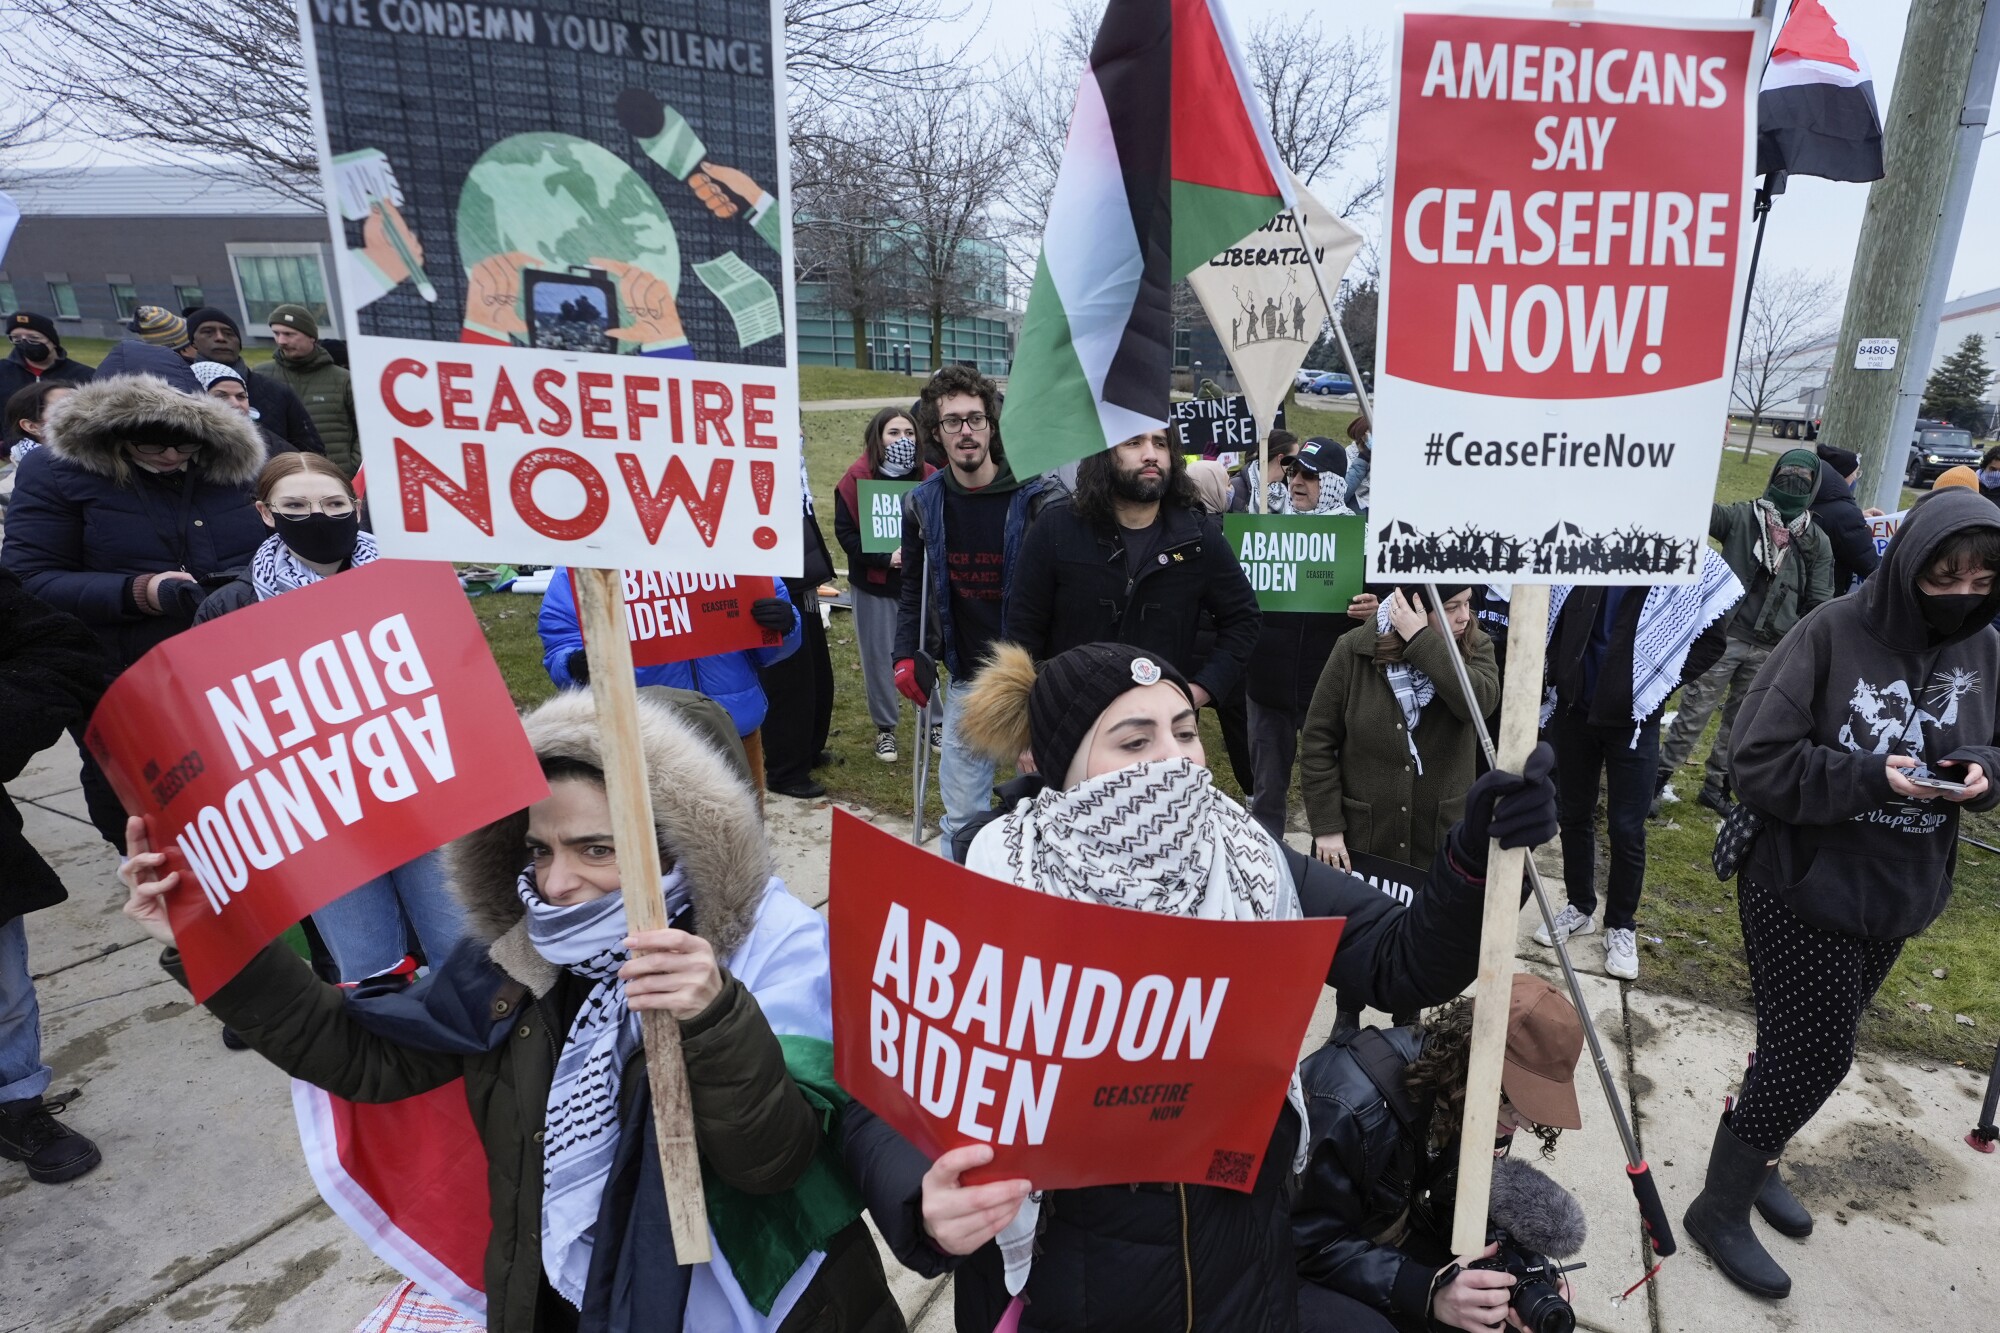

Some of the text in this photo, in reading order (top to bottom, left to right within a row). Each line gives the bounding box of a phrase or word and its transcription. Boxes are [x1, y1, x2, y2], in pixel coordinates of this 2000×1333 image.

[313, 0, 371, 28] WE
[378, 0, 535, 44] CONDEMN
[542, 11, 635, 57] YOUR
[640, 27, 764, 76] SILENCE
[1421, 40, 1727, 109] AMERICANS
[1531, 115, 1617, 171] SAY
[1403, 187, 1730, 267] CEASEFIRE
[1452, 283, 1669, 375] NOW!
[1859, 345, 1896, 355] 8480-S
[379, 357, 778, 450] CEASEFIRE
[1170, 396, 1237, 420] LESTINE
[1424, 431, 1676, 468] #CeaseFireNow
[393, 437, 779, 550] NOW!
[1240, 531, 1336, 562] ABANDON
[620, 569, 736, 602] BANDON
[1306, 570, 1334, 579] CEASEFIRE
[624, 597, 692, 642] IDEN
[702, 599, 739, 614] CEASEFIRE
[205, 613, 434, 771] BIDEN
[176, 694, 456, 915] ABANDON
[1868, 809, 1915, 828] Vape
[1920, 812, 1947, 827] Shop
[872, 901, 1230, 1062] ABANDON
[870, 988, 1062, 1146] BIDEN
[1093, 1082, 1194, 1108] CEASEFIRE
[1149, 1105, 1184, 1122] NOW
[1526, 1265, 1544, 1273] Canon
